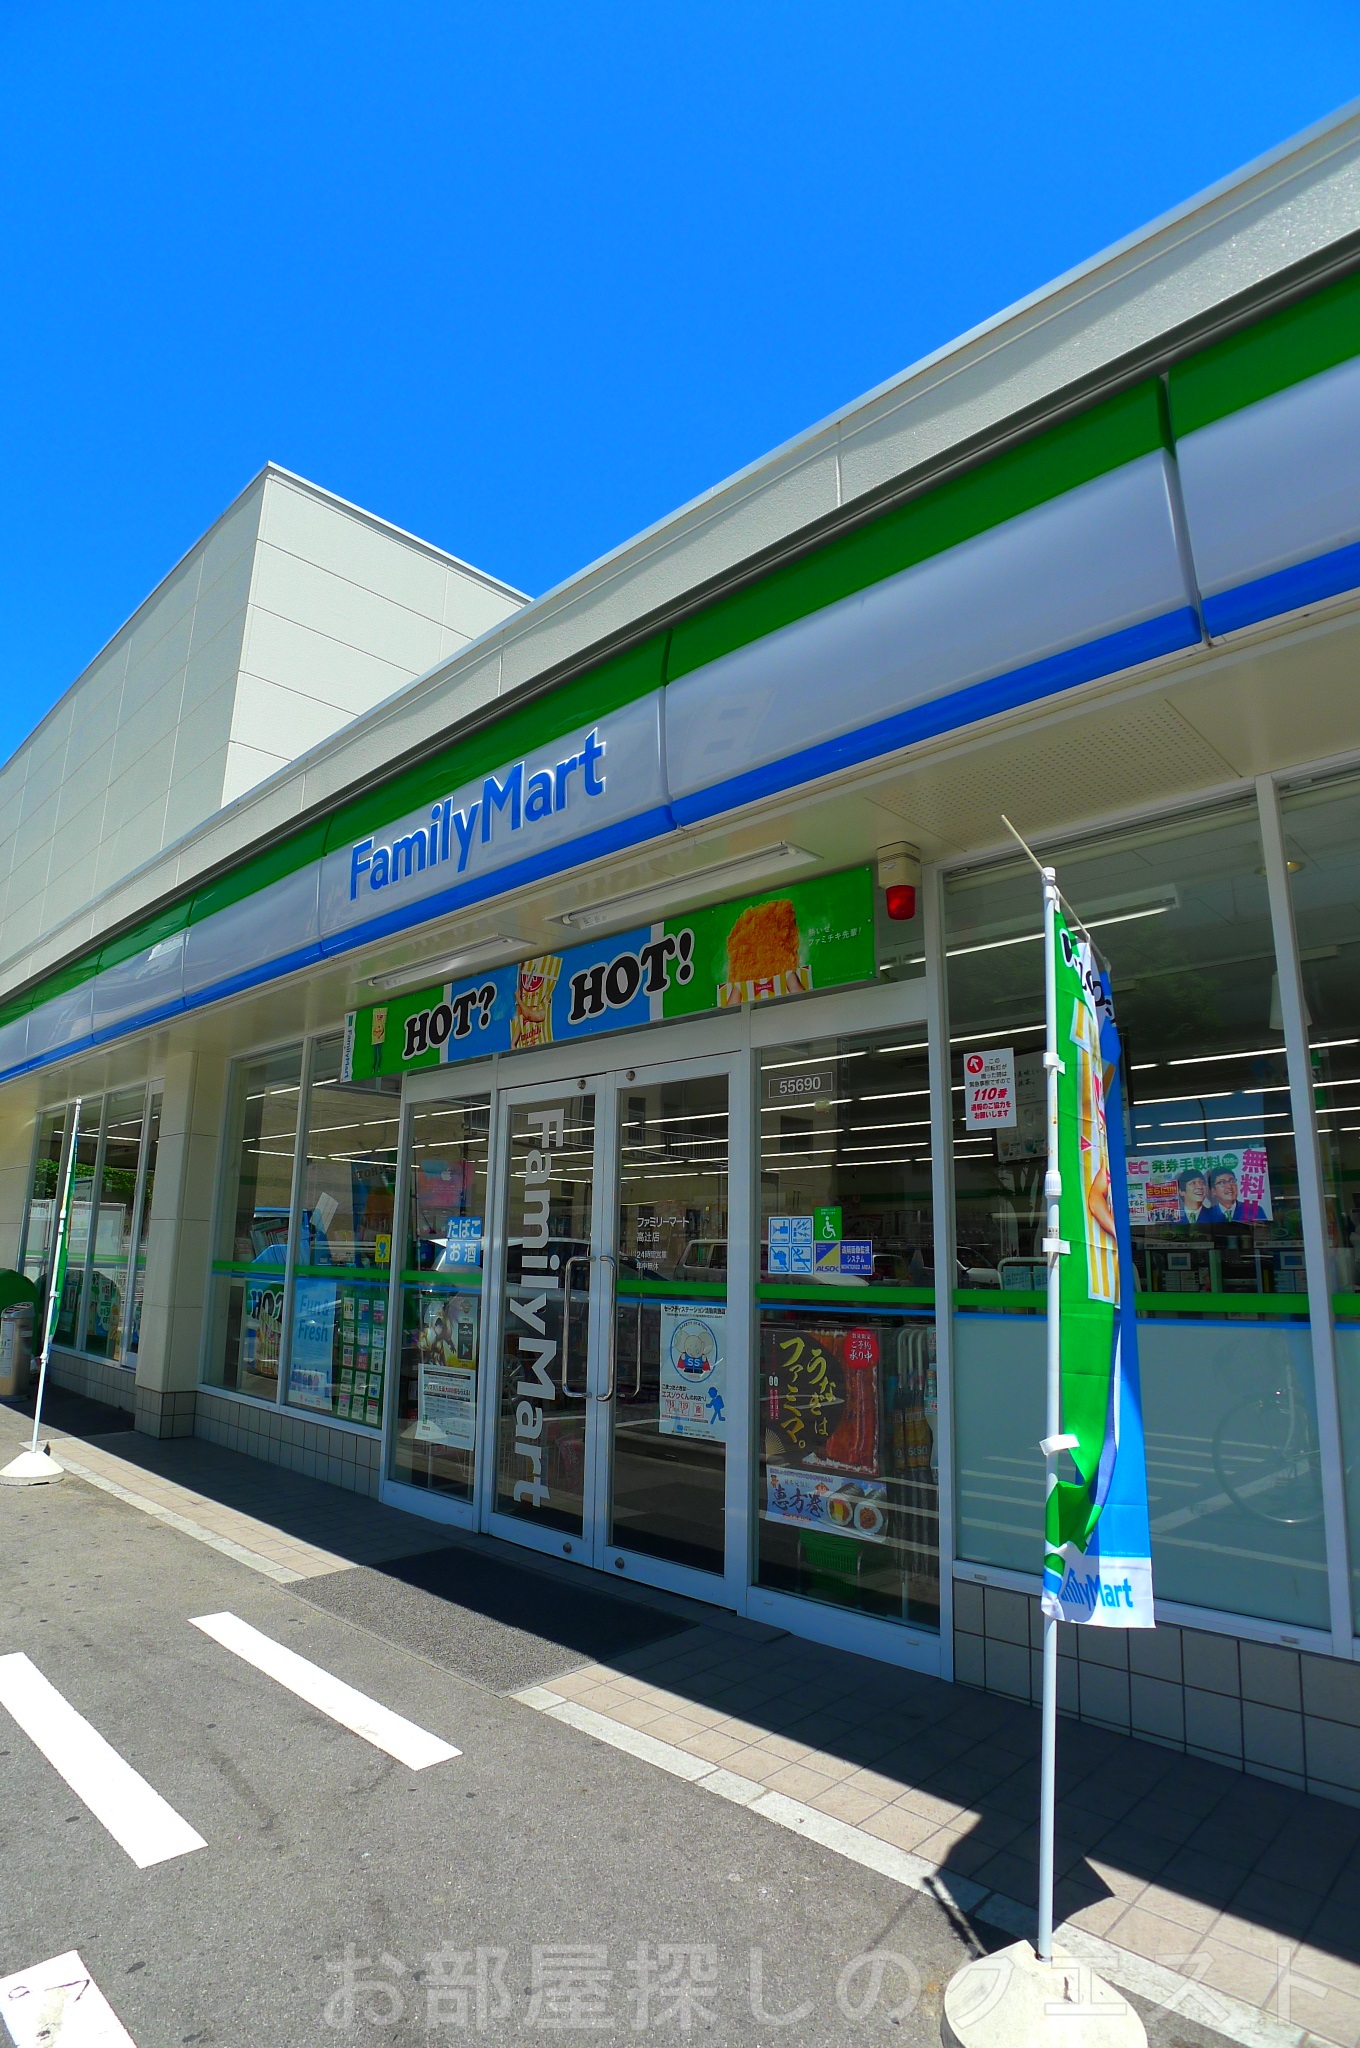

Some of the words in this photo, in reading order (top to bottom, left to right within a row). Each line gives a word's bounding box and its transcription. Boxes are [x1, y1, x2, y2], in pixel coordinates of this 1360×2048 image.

[350, 727, 607, 899] FamilyMart
[570, 929, 694, 1022] HOT!
[405, 987, 495, 1056] HOT?
[344, 1029, 352, 1079] FamilyMart
[778, 1075, 822, 1093] 55690
[973, 1087, 1009, 1101] 110番
[973, 1110, 1010, 1120] お願いします
[1152, 1156, 1220, 1174] 発券手数料
[447, 1219, 481, 1238] たばこ
[637, 1216, 690, 1228] ファミリーマート
[449, 1243, 477, 1263] お酒
[636, 1250, 667, 1259] 24時間営業
[509, 1108, 564, 1508] FamilyMart
[298, 1319, 329, 1342] Fresh
[851, 1341, 872, 1350] ご予約
[687, 1358, 700, 1366] SS
[807, 1348, 837, 1437] うなぎは
[772, 1483, 825, 1518] 恵方巻
